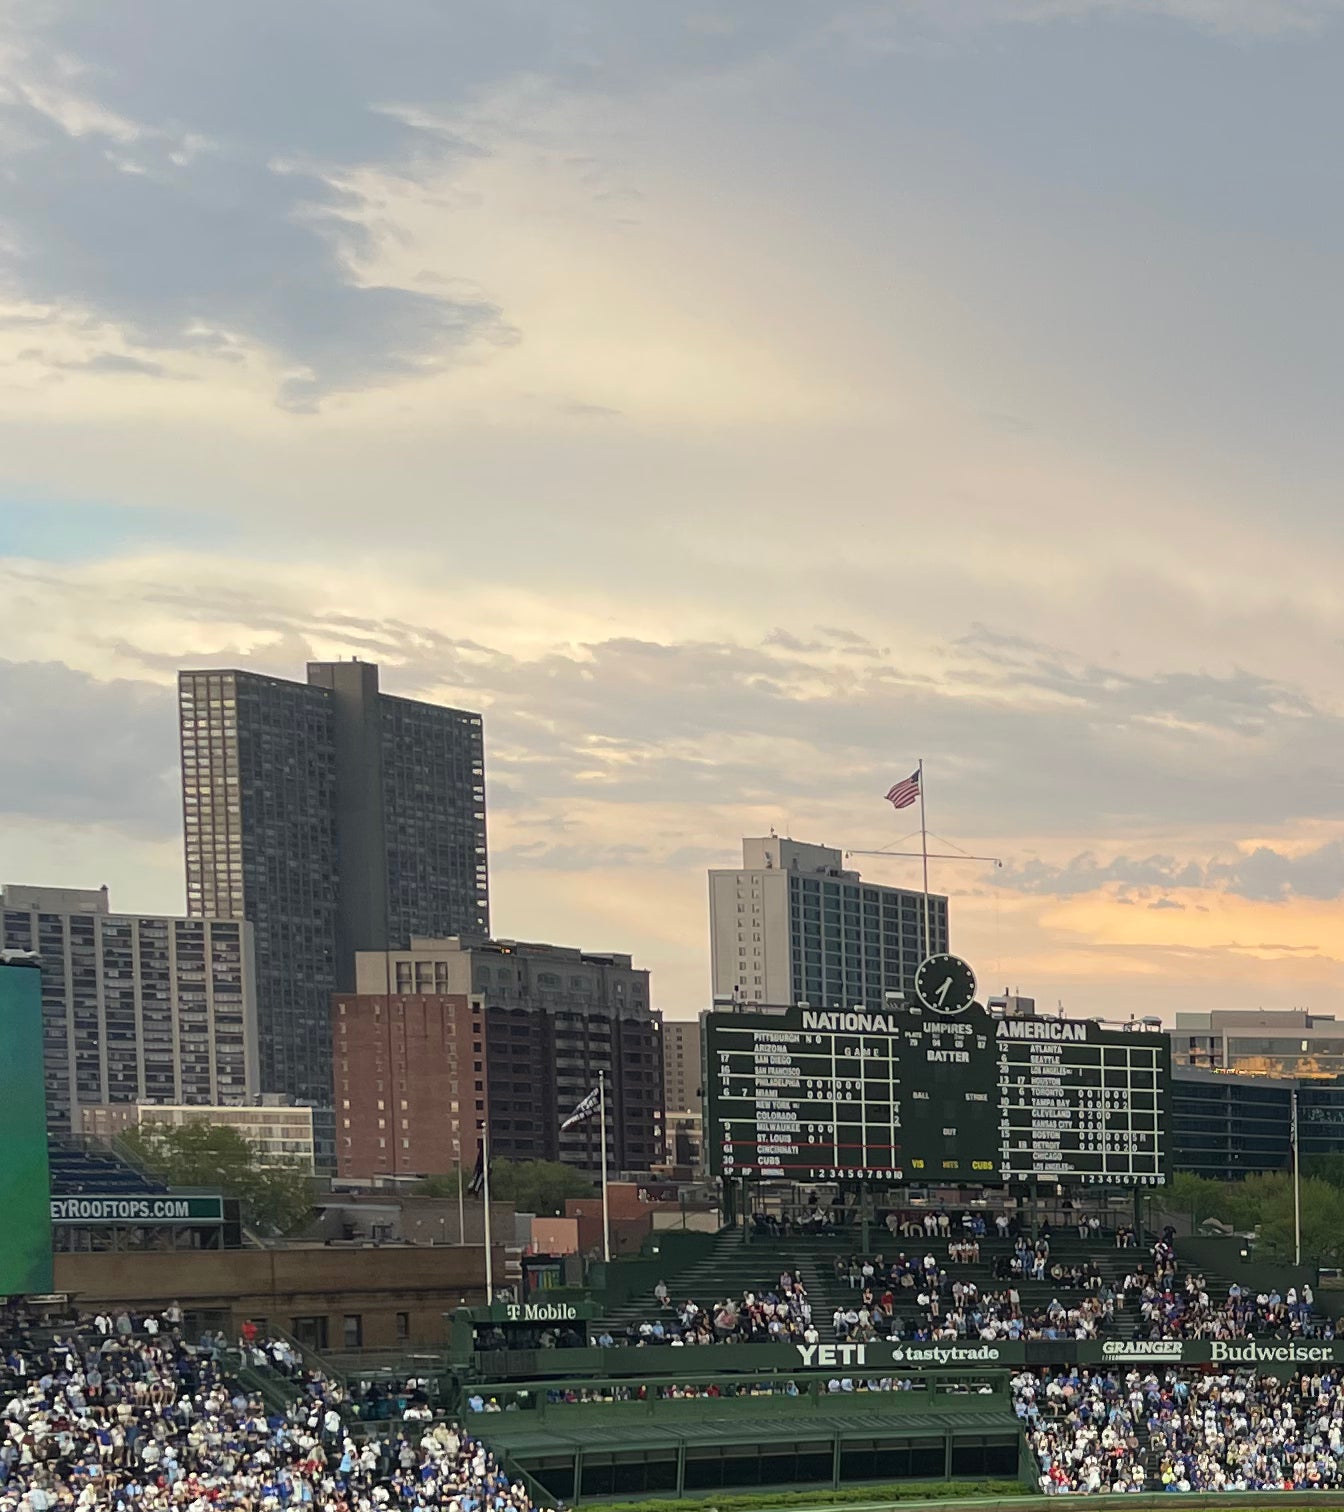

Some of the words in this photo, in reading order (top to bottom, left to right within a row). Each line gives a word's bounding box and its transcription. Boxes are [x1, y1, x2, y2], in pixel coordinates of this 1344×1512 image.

[802, 1011, 899, 1032] NATIONAL
[923, 1022, 973, 1034] UMPIRES
[996, 1021, 1086, 1040] AMERICAN
[754, 1032, 800, 1042] PITTSBURGH
[754, 1044, 787, 1053] ARIZONA
[999, 1044, 1008, 1052] 12
[1030, 1044, 1063, 1054] ATLANTA
[927, 1050, 969, 1062] BATTER
[1030, 1055, 1060, 1064] SEATTLE
[756, 1111, 797, 1120] COLORADO
[723, 1155, 734, 1165] 30
[757, 1156, 780, 1165] CUBS
[972, 1161, 993, 1170] CUBS
[810, 1169, 814, 1178] 1
[819, 1169, 825, 1178] 2
[829, 1169, 835, 1178] 3
[838, 1169, 844, 1178] 4
[847, 1170, 854, 1178] 5
[857, 1170, 863, 1178] 6
[866, 1170, 873, 1178] 7
[876, 1171, 882, 1179] 8
[885, 1171, 892, 1179] 9
[893, 1171, 903, 1179] 10
[507, 1304, 520, 1320] T
[524, 1303, 576, 1320] Mobile
[1102, 1341, 1183, 1354] GRAINGER
[1210, 1341, 1332, 1361] Budweiser
[796, 1344, 866, 1366] YETI
[905, 1346, 999, 1364] tastytrade
